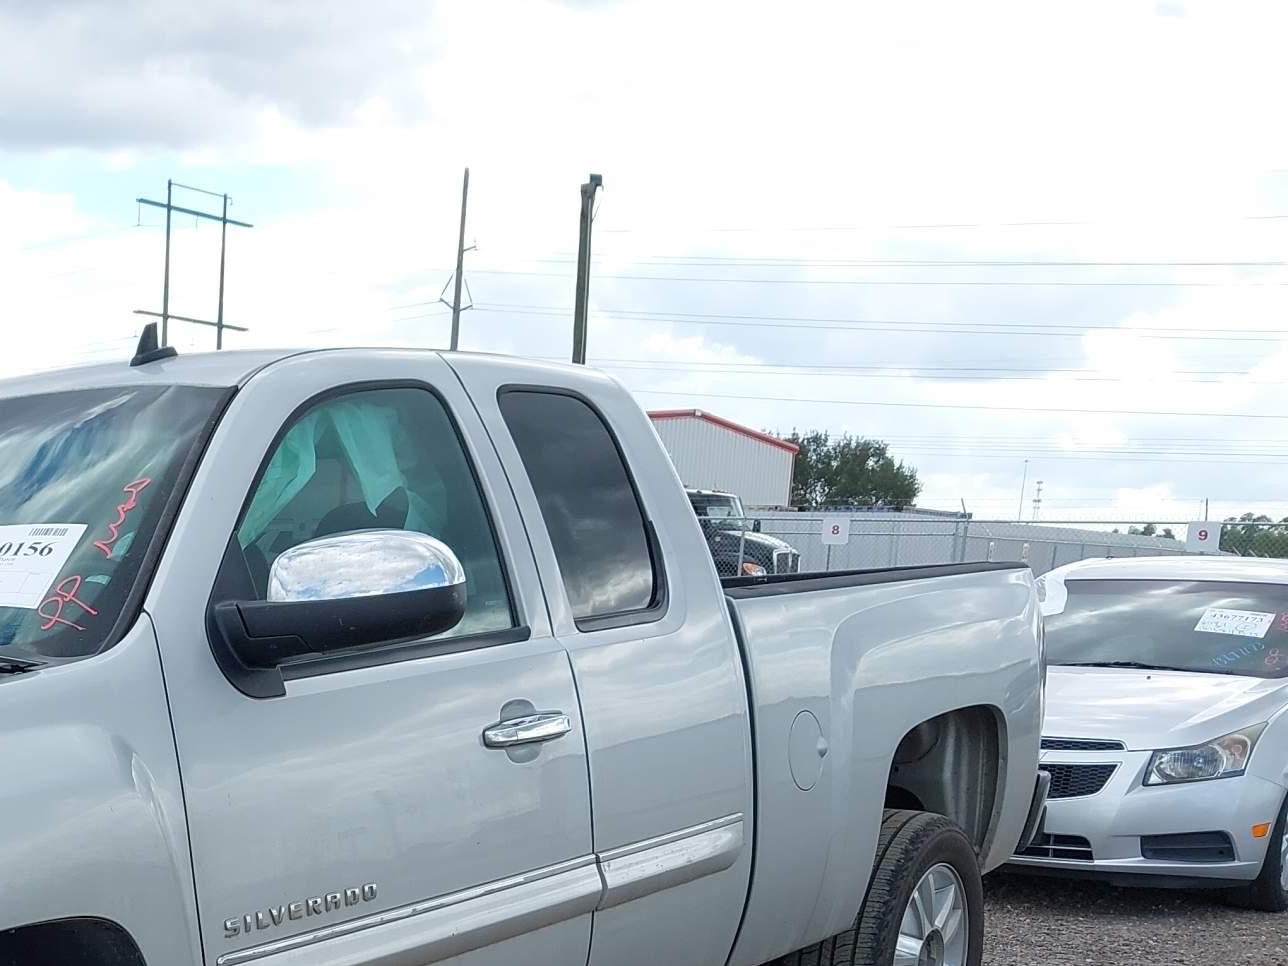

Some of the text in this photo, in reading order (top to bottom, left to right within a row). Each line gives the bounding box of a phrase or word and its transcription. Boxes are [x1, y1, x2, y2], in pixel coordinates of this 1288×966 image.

[831, 524, 840, 535] 8
[1198, 529, 1208, 541] 9
[223, 882, 378, 938] SILVERADO
